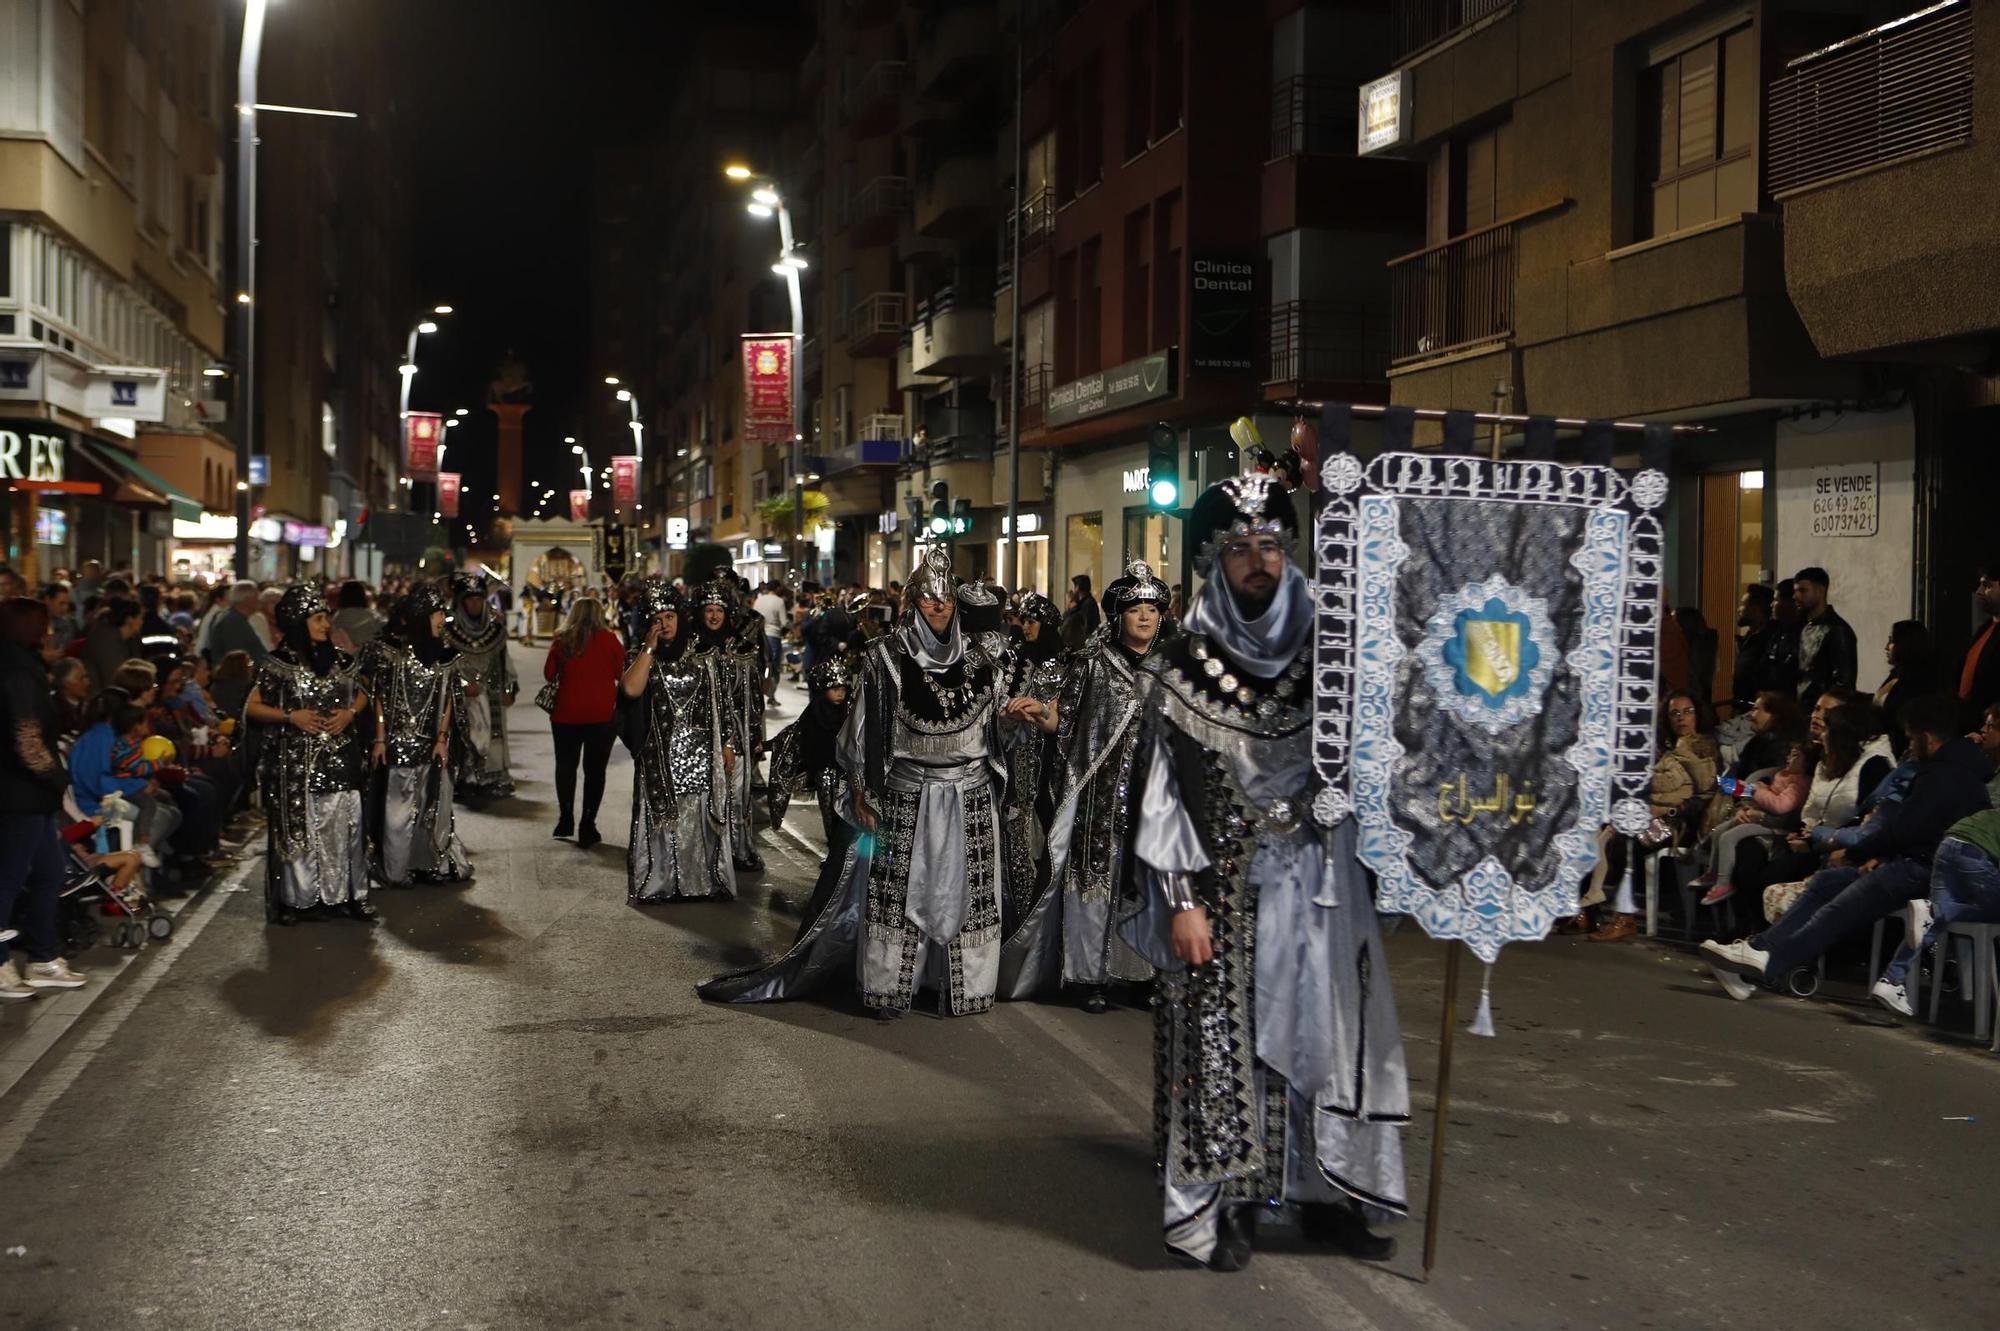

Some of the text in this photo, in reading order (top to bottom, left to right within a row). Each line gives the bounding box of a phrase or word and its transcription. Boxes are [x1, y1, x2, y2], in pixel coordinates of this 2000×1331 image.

[1194, 277, 1252, 291] Dental
[1075, 374, 1104, 400] Dental
[1816, 475, 1872, 494] SE VENDE
[1438, 769, 1510, 826] السراج
